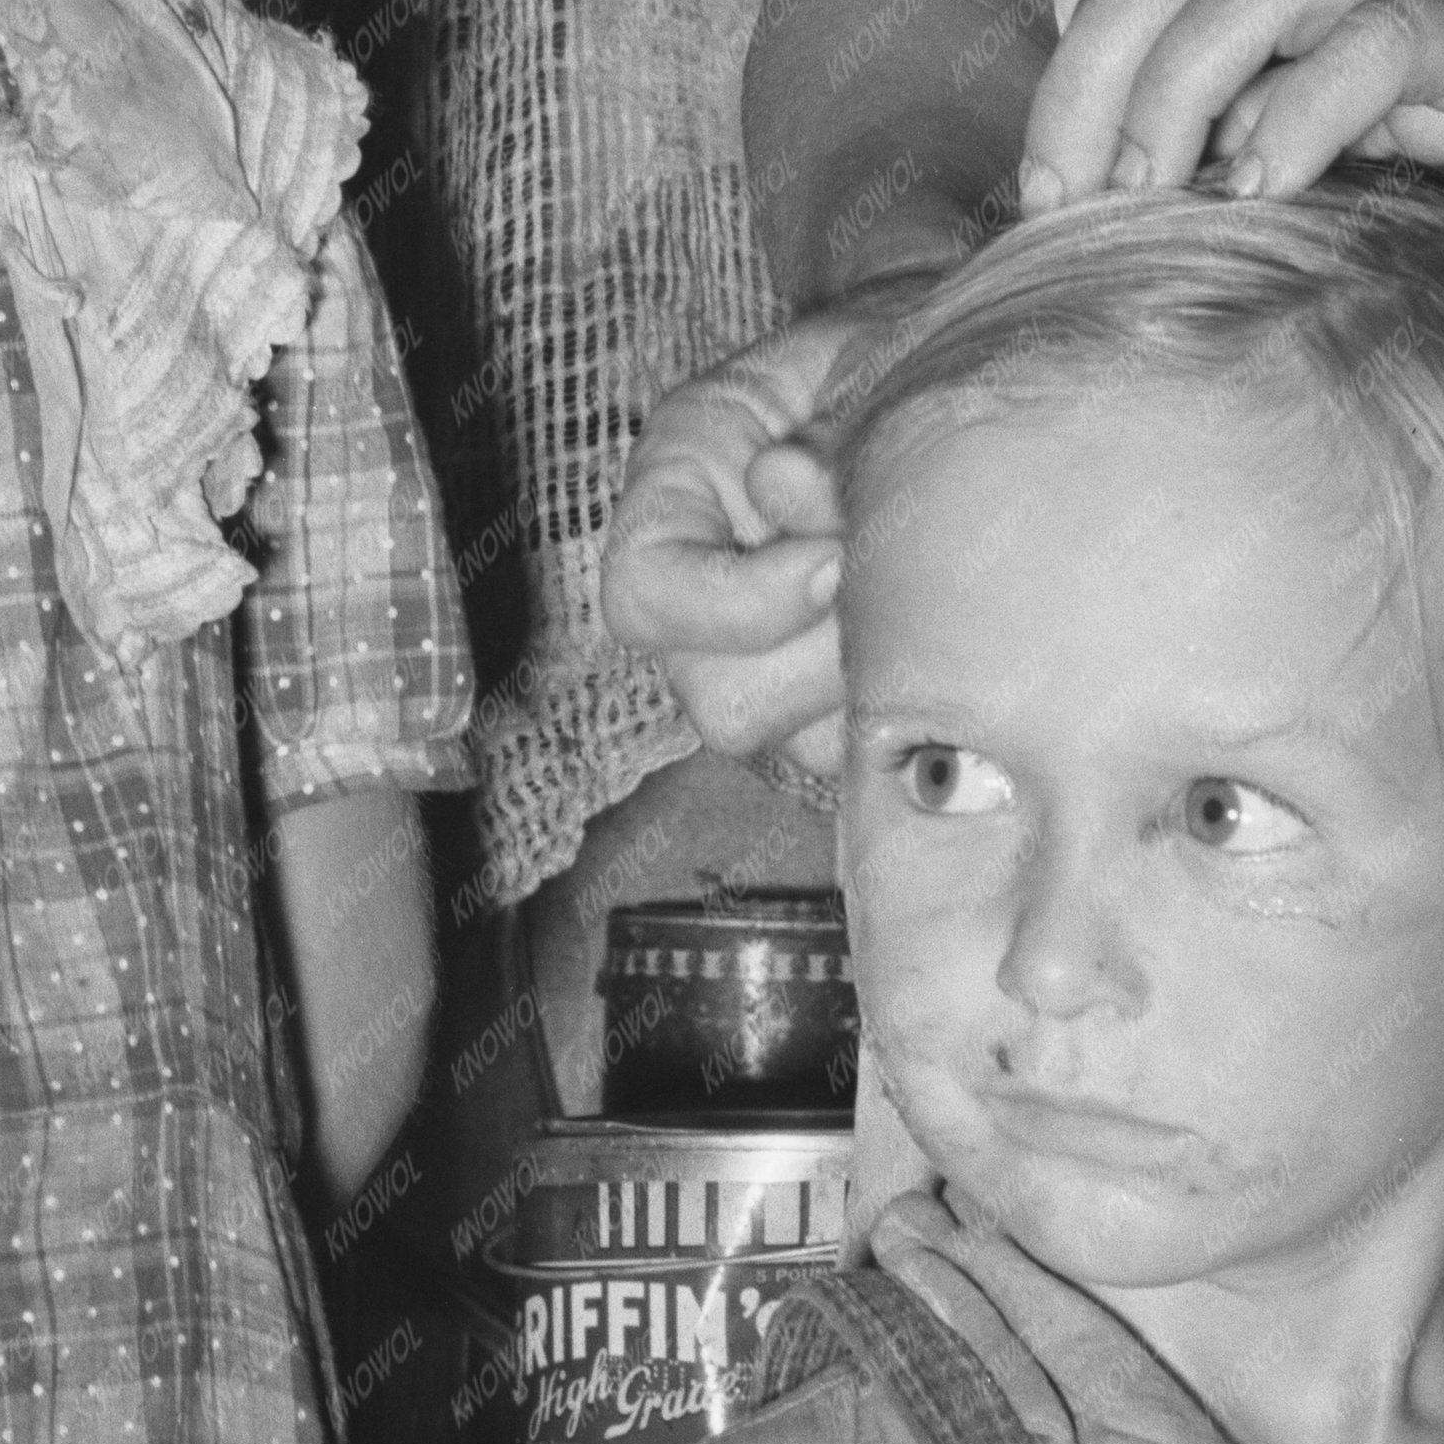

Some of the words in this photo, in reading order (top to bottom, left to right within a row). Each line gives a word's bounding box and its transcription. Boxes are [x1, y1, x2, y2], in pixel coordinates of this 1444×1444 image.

[514, 1281, 783, 1406] RIFFIN'
[529, 1347, 612, 1442] High
[604, 1364, 744, 1441] Grade
